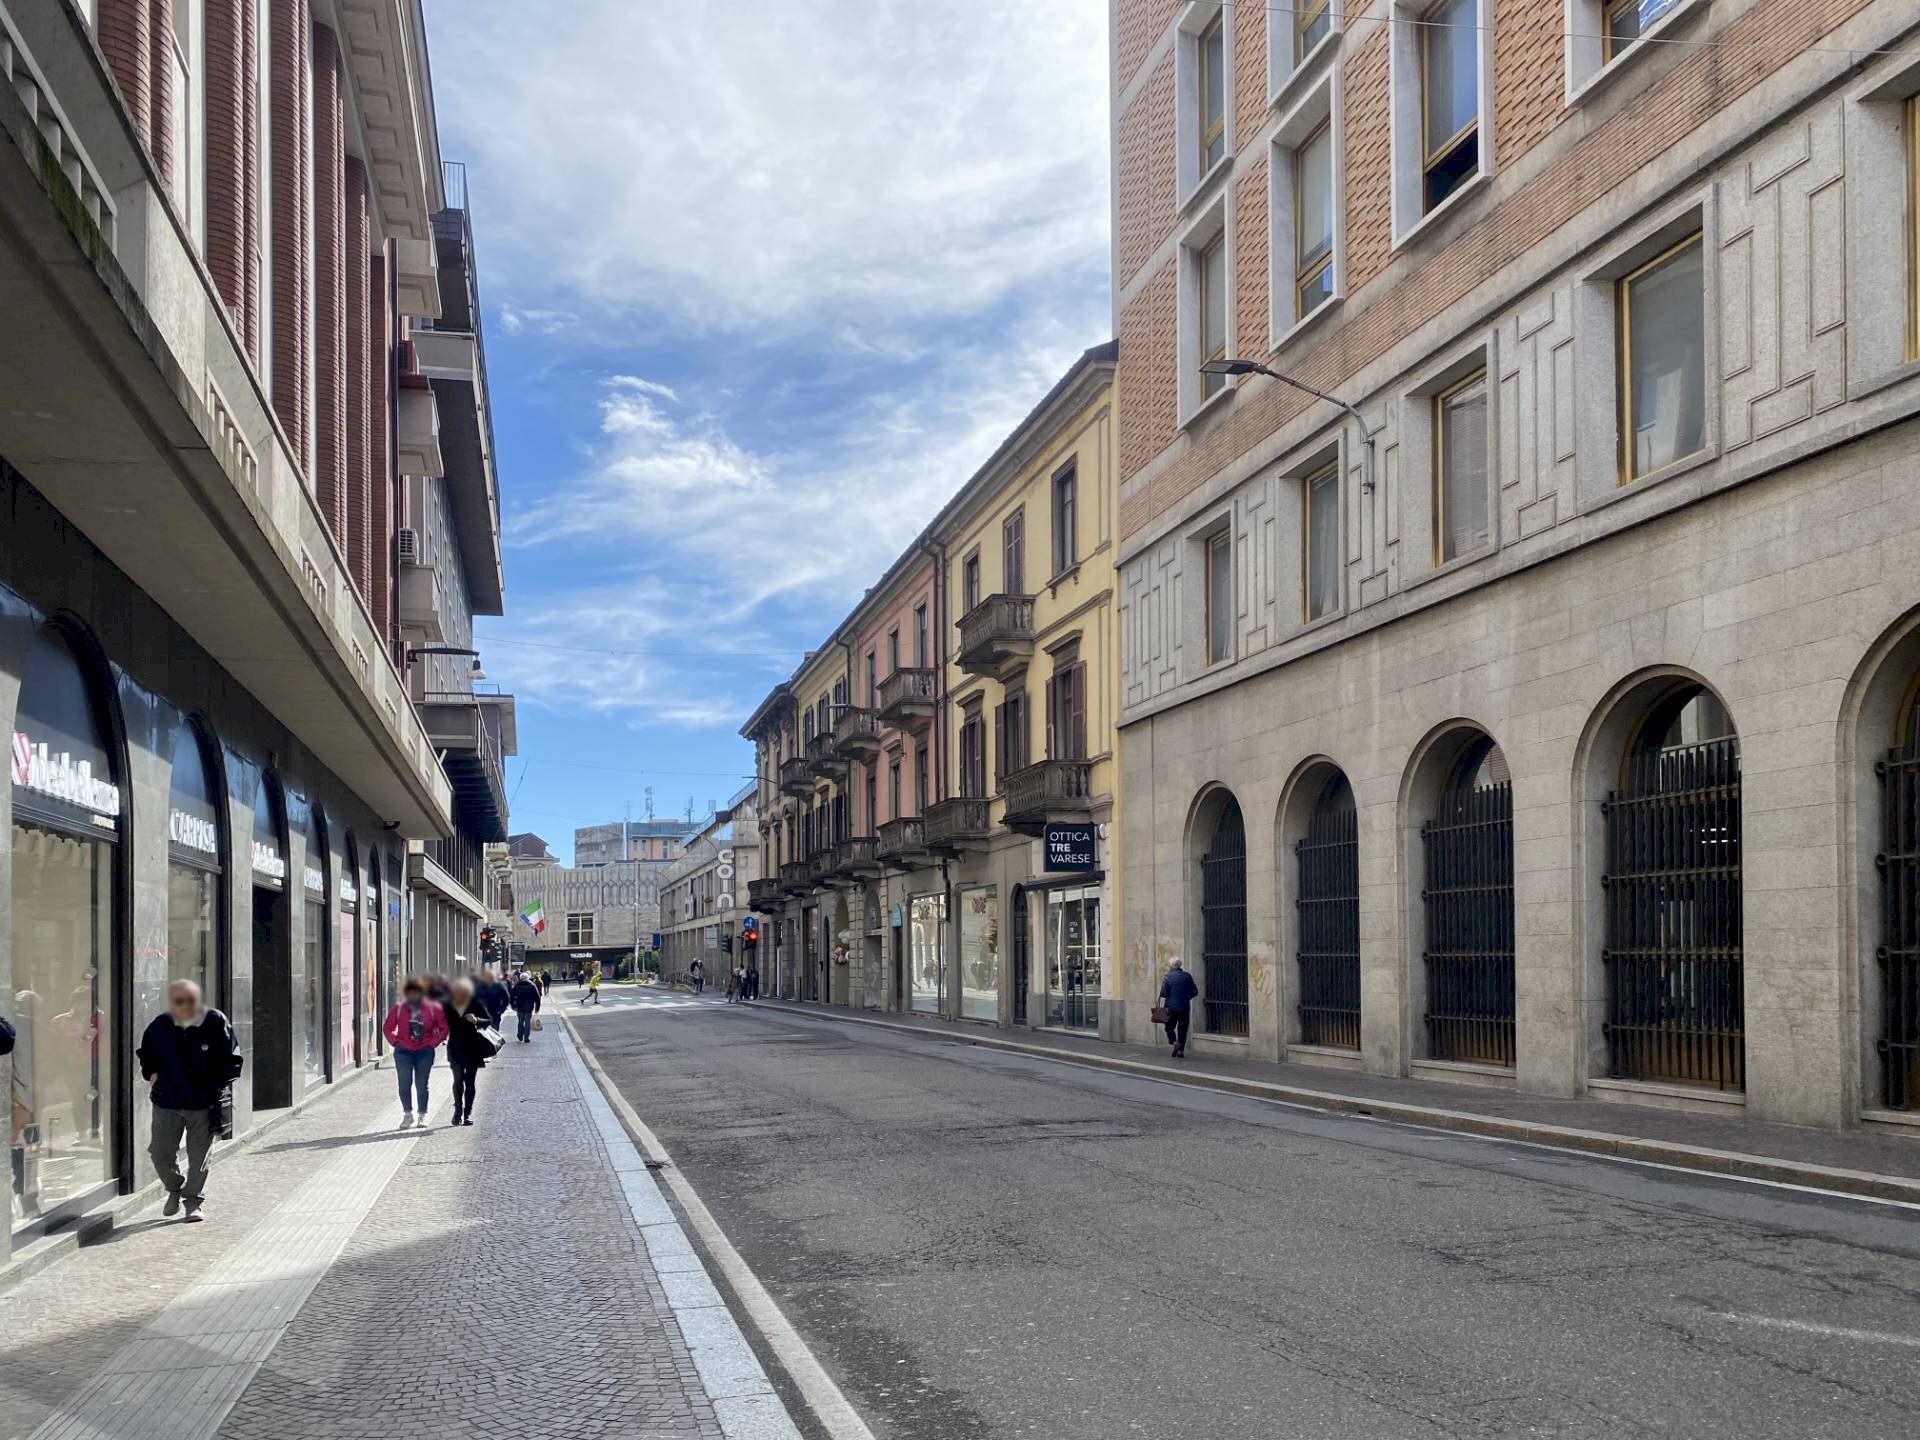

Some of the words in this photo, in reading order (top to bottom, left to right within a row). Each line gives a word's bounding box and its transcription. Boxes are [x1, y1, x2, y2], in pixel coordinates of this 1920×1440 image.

[169, 808, 216, 853] CARPISA
[1049, 831, 1090, 841] OTTICA
[1050, 843, 1071, 852] TRE
[1050, 854, 1091, 863] VARESE
[716, 849, 735, 908] coin
